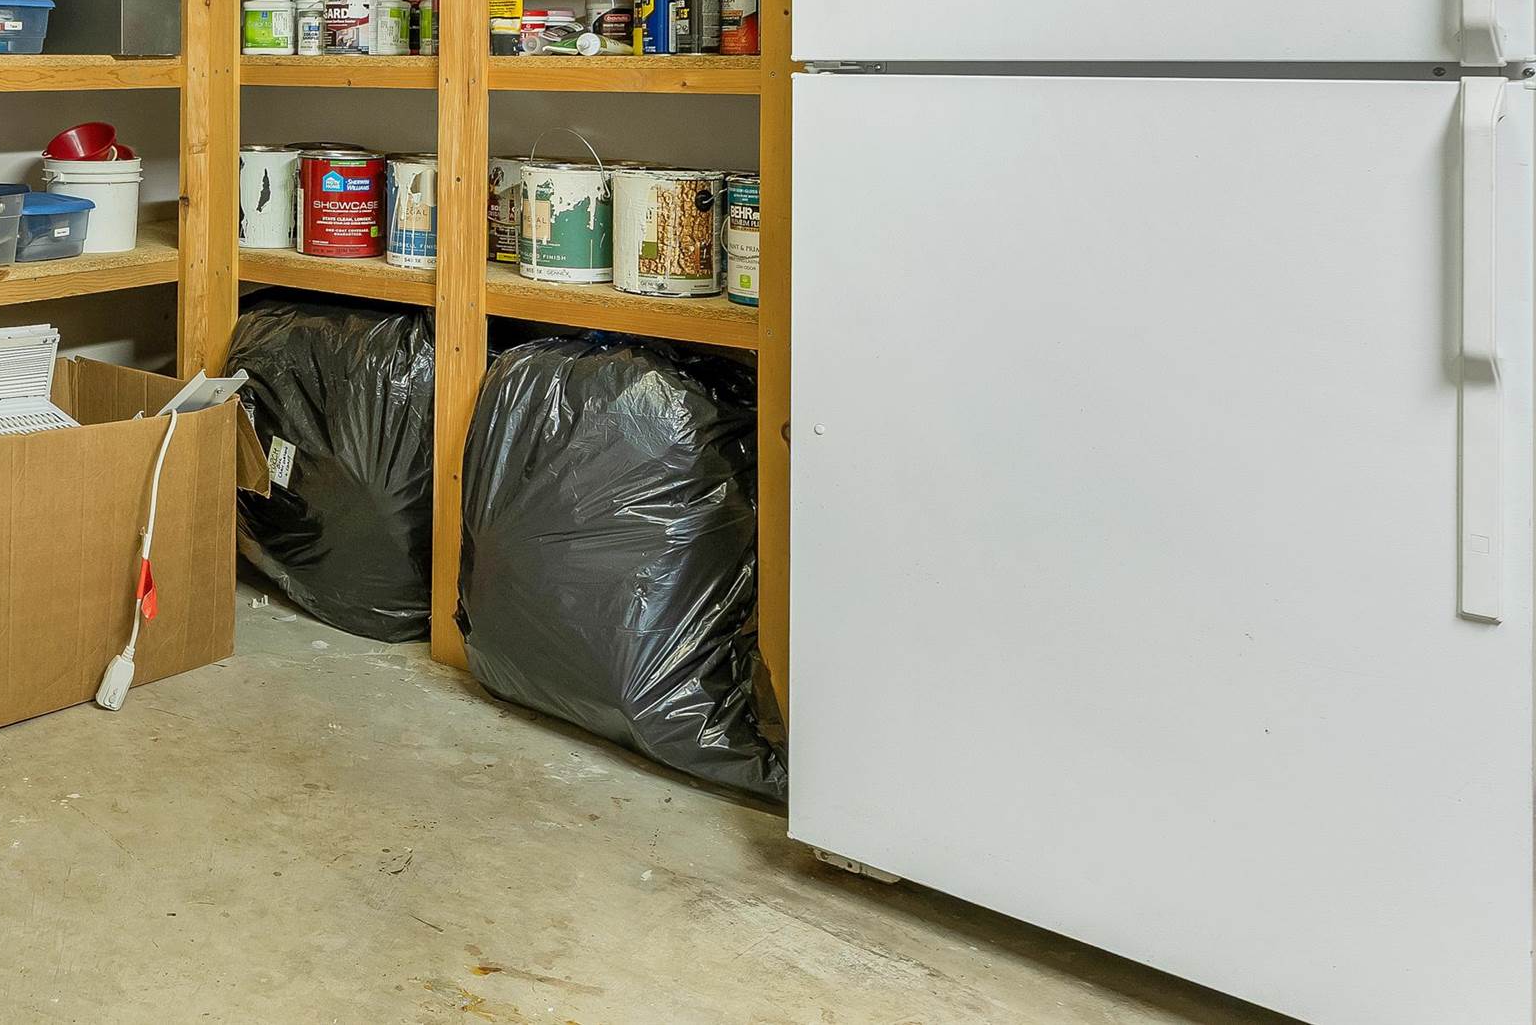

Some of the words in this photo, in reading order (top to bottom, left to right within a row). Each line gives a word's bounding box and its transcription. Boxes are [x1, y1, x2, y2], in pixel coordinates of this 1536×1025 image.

[313, 200, 378, 210] SHOWCASE
[405, 207, 428, 216] EGAL
[730, 205, 753, 220] BEHR
